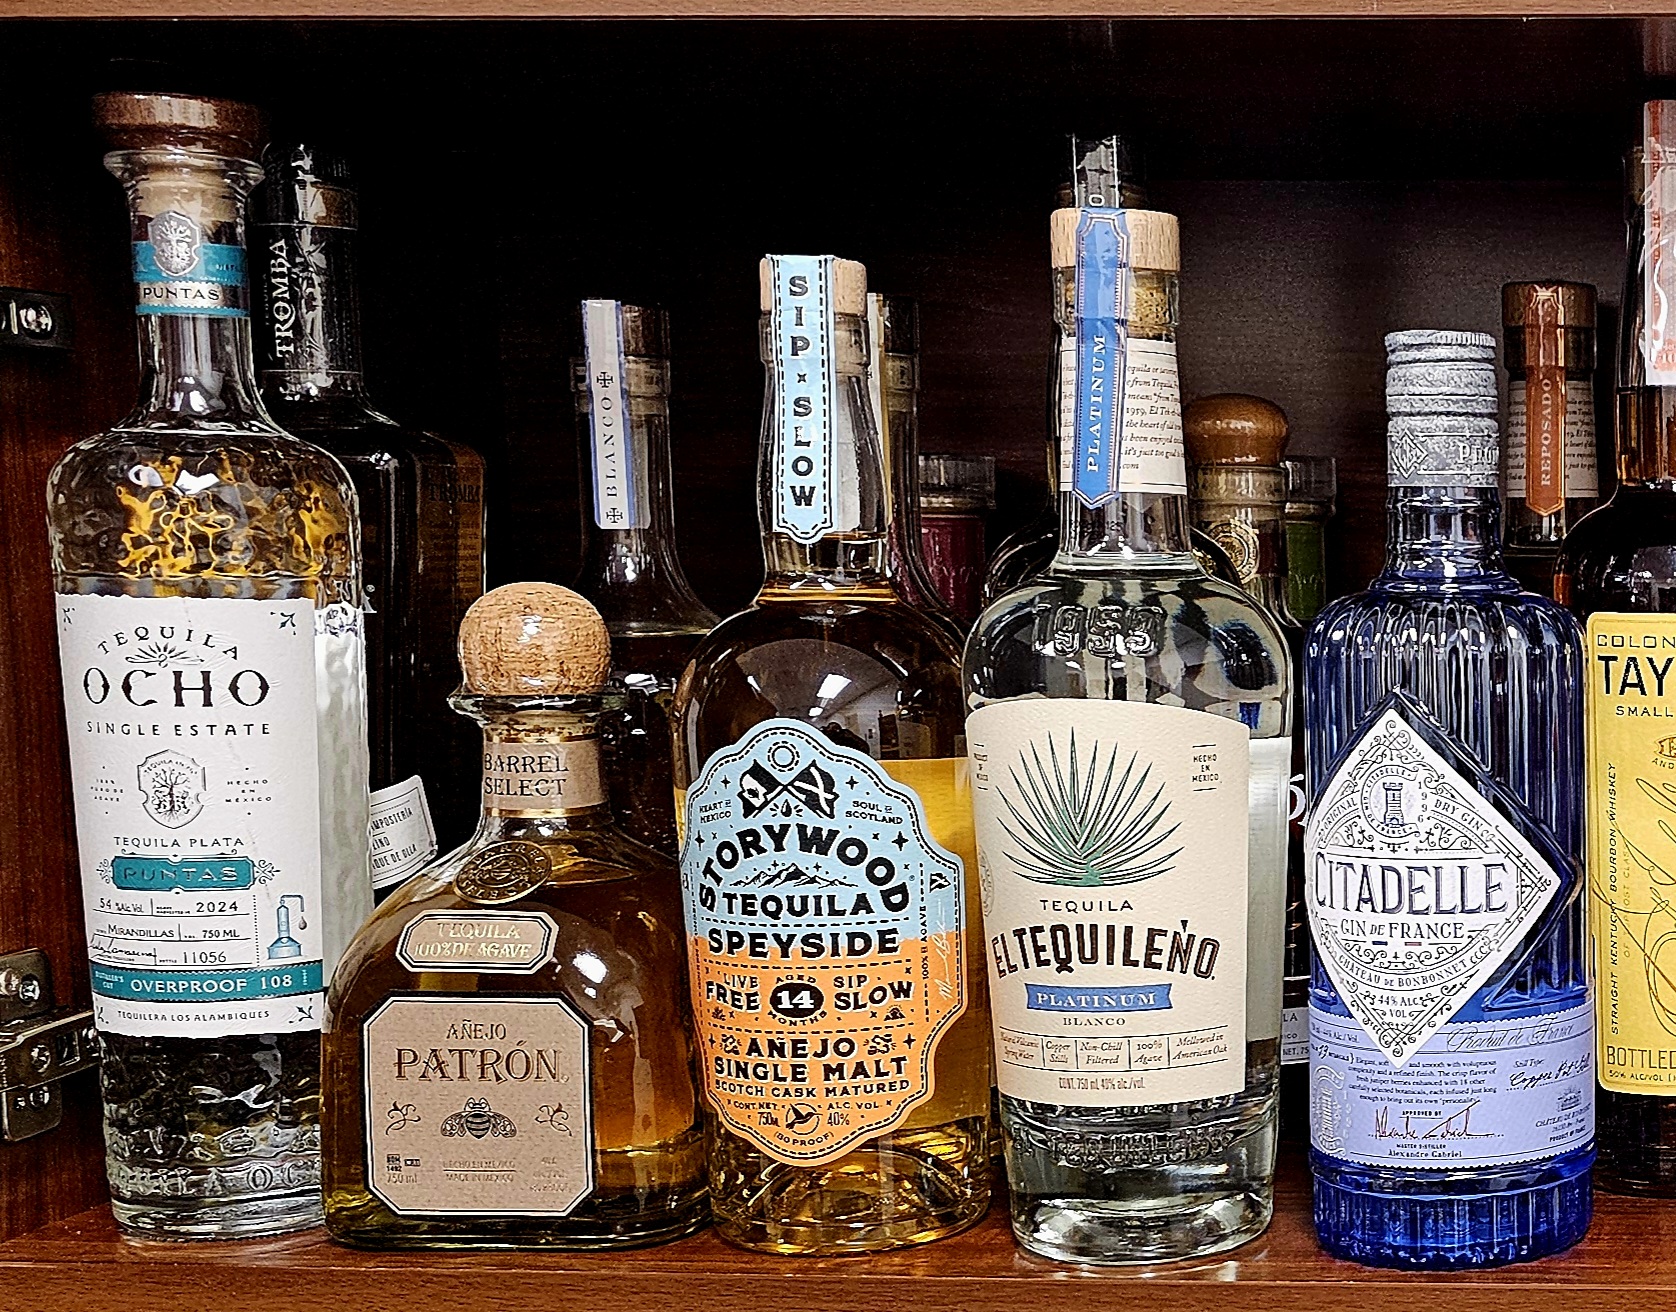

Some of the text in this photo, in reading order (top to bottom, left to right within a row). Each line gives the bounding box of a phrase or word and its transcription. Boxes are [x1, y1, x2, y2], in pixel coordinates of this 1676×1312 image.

[143, 287, 220, 300] PUNTAS
[273, 238, 295, 359] TROMBA
[789, 276, 816, 507] SIP SLOW
[1086, 334, 1105, 472] PLATINUM
[1540, 378, 1552, 486] REPOSADO
[602, 397, 617, 497] BLANCO
[98, 626, 238, 661] TEQUILA
[83, 668, 270, 707] OCHO
[1616, 706, 1673, 717] SMALL
[87, 721, 270, 735] SINGLE ESTATE
[484, 753, 569, 772] BARREL
[1193, 754, 1217, 762] HECHO
[484, 778, 567, 797] SELECT
[1608, 763, 1616, 827] WHISKEY
[852, 800, 882, 812] SOUL
[1322, 798, 1358, 831] ORIGINAL
[1434, 800, 1483, 831] DRY GIN
[845, 811, 903, 824] SCOTLAND
[114, 837, 245, 847] TEQUILA PLATA
[124, 867, 238, 881] PUNTAS
[700, 823, 910, 913] STORYWOOD
[1316, 852, 1508, 915] CITADELLE
[196, 901, 238, 912] 2024
[722, 892, 874, 920] TEQUILA
[1040, 899, 1133, 913] TEQUILA
[108, 924, 240, 938] MIRANDILLAS 750 ML
[438, 923, 521, 939] TEQUILA
[1340, 919, 1465, 939] GIN FRANCE
[1610, 899, 1619, 965] KENTUCKY
[708, 928, 900, 959] SPEYSIDE
[992, 920, 1220, 980] EL TEQUILEÑO
[183, 951, 226, 964] 11056
[724, 974, 868, 988] LIVE SIP
[1398, 960, 1468, 988] BONBONNET
[131, 975, 292, 994] OVERPROOF 108
[706, 981, 912, 1011] FREE 14 SLOW
[1036, 992, 1155, 1007] PLATINUM
[1610, 972, 1619, 1035] STRAIGHT
[117, 1010, 270, 1021] TEQUILERA LOS ALAMBIQUES
[1063, 1017, 1126, 1026] BLANCO
[447, 1019, 506, 1040] AÑEJO
[1448, 1026, 1506, 1052] Produit
[746, 1038, 856, 1059] AÑEJO
[1045, 1041, 1070, 1055] Copper
[394, 1040, 560, 1085] PATRÓN
[1086, 1054, 1119, 1065] Filtered
[714, 1056, 908, 1084] SINGLE MALT
[715, 1080, 910, 1098] SCOTCH CASK MATURED
[1388, 1150, 1429, 1158] Alexandre
